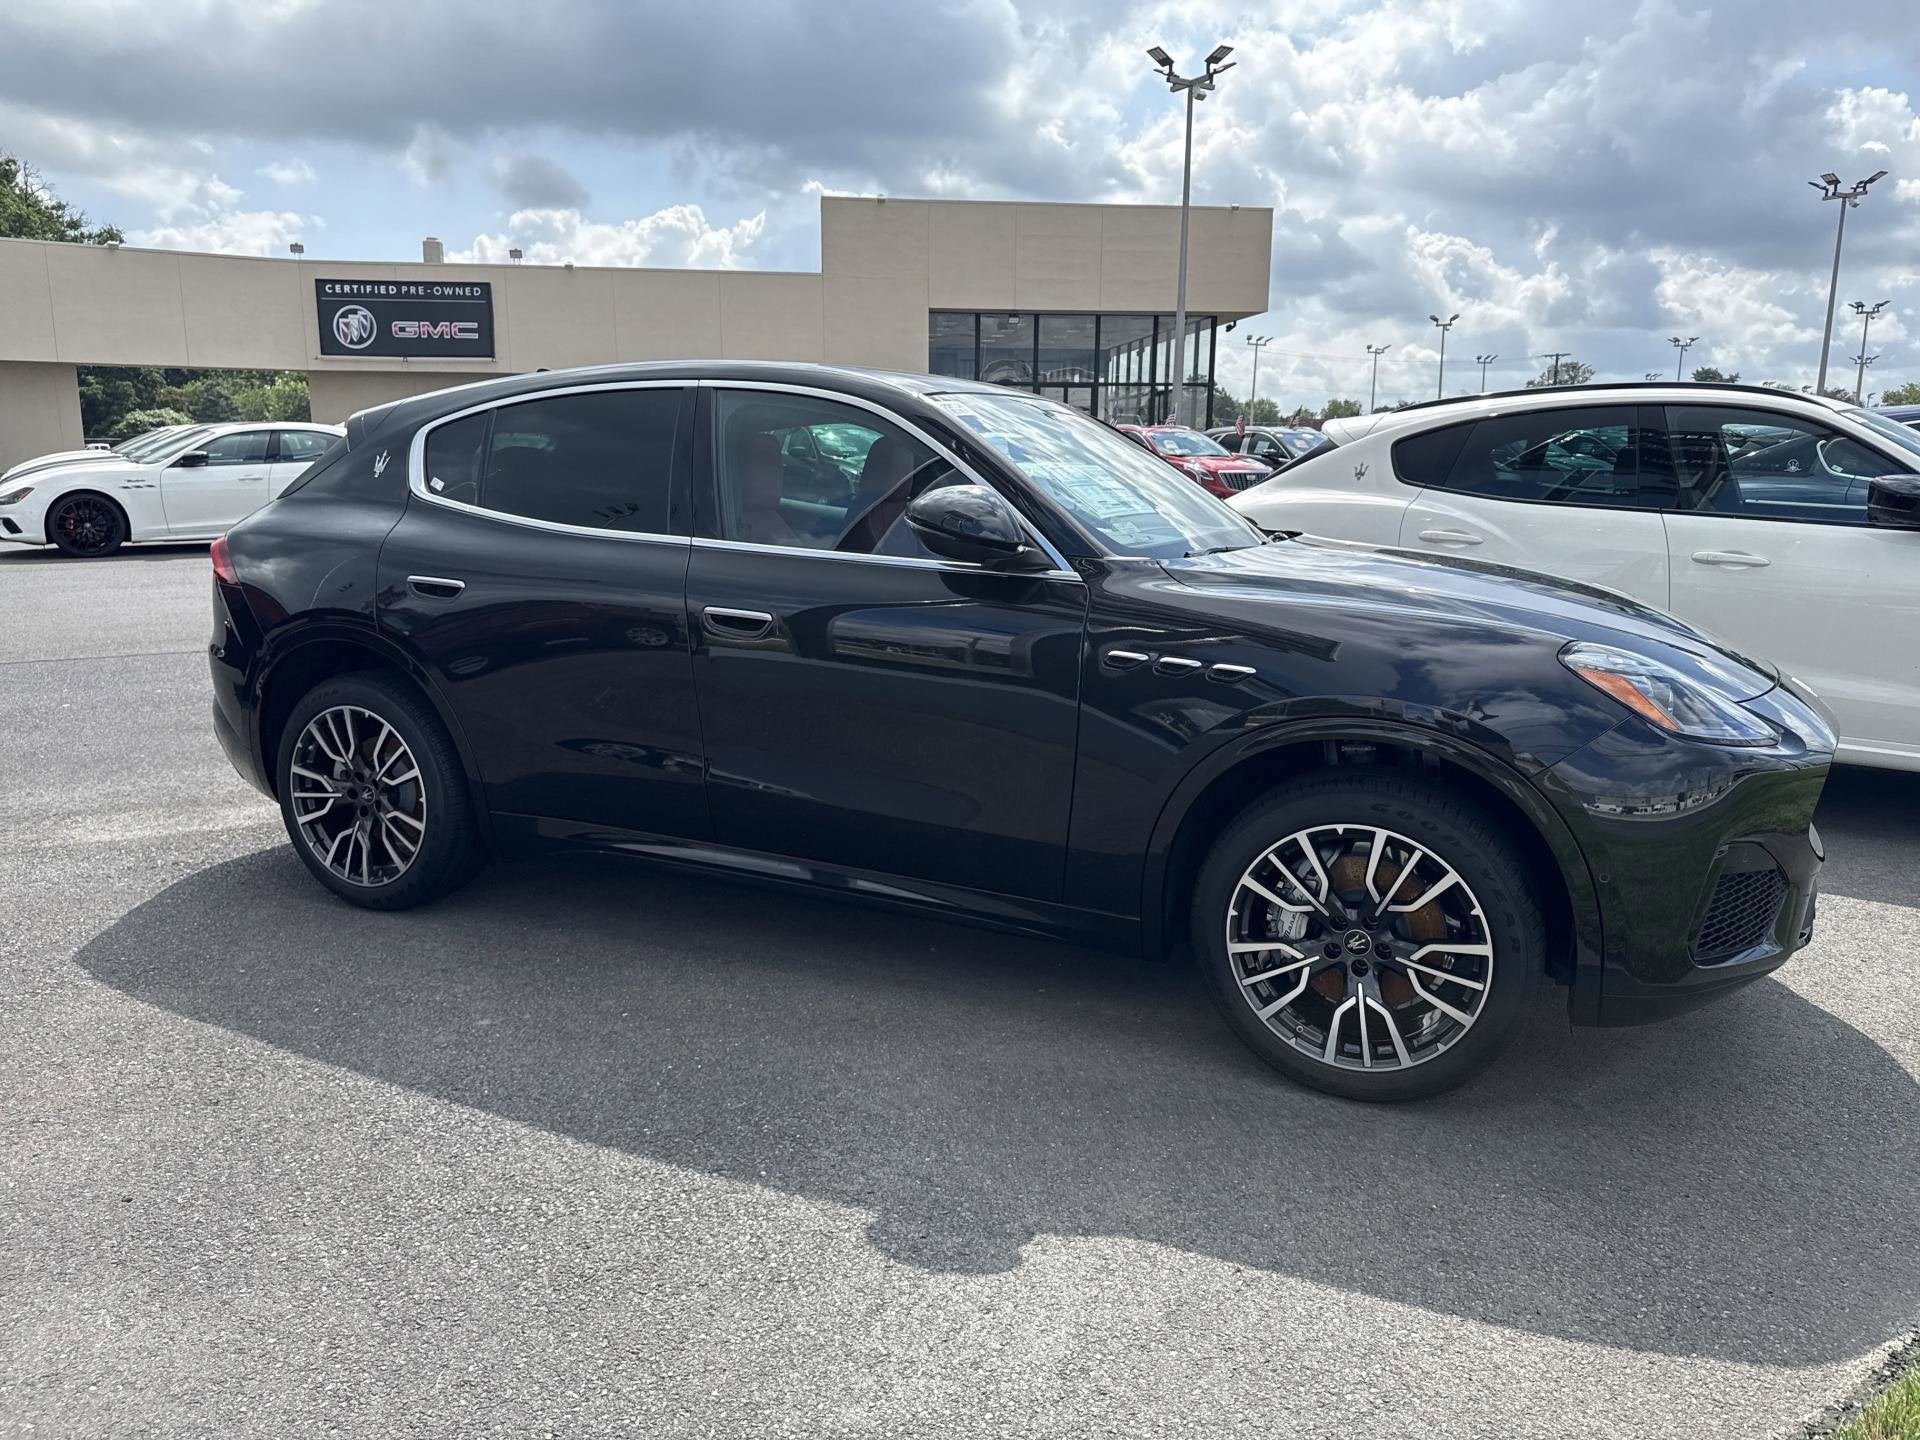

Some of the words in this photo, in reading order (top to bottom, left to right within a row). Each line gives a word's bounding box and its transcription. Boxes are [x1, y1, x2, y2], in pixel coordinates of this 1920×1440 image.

[325, 284, 397, 295] CERTIFIED
[401, 286, 481, 296] PRE-OWNED
[392, 321, 479, 339] GMC
